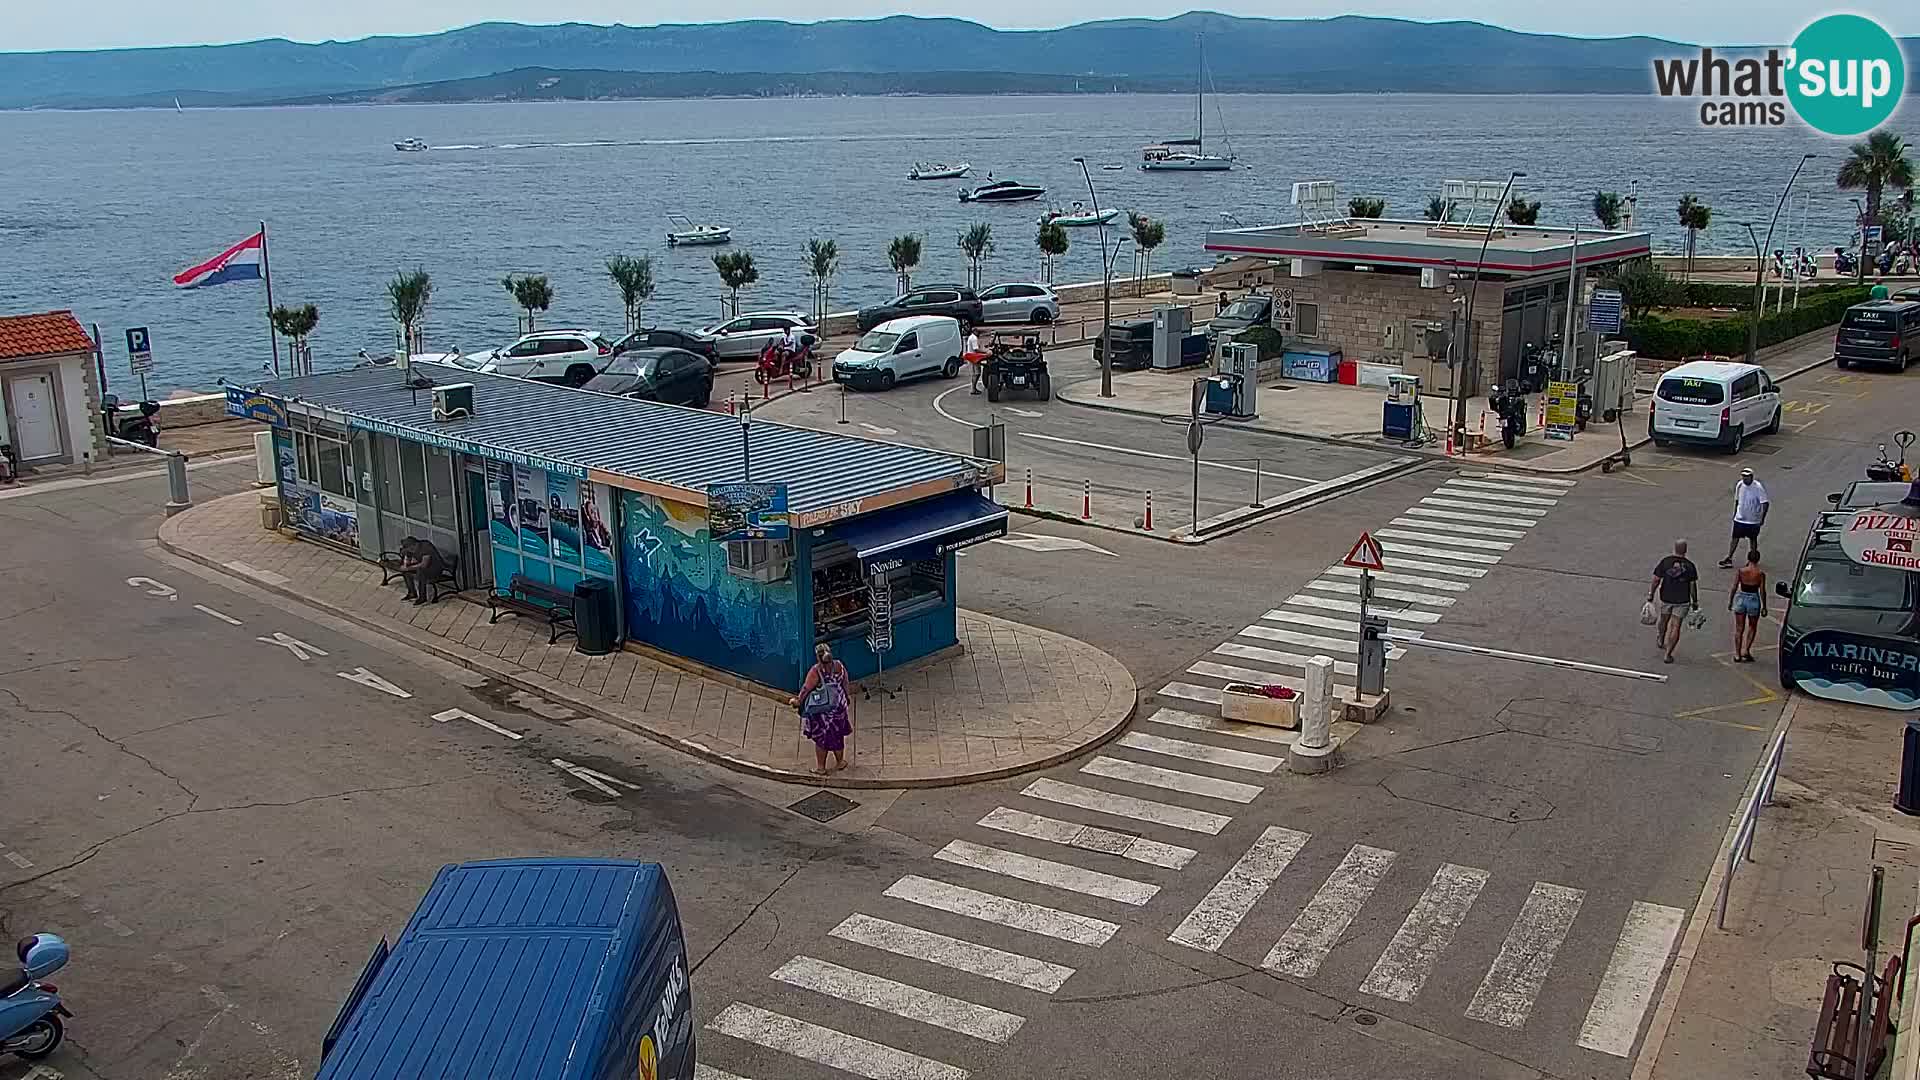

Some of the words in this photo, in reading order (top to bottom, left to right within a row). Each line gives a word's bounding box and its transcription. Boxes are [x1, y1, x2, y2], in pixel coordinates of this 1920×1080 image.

[1863, 311, 1880, 319] TAXI
[397, 428, 438, 444] AUTOBUSNA
[439, 437, 470, 452] POSTAJA
[480, 446, 495, 456] BUS
[495, 449, 528, 465] STATION
[529, 457, 555, 471] TICKET
[556, 463, 584, 477] OFFICE
[1850, 515, 1920, 532] PIZZE
[1884, 530, 1919, 540] GRILL
[1802, 642, 1920, 673] MARINER
[1831, 662, 1867, 675] caffe
[1872, 665, 1899, 680] bar
